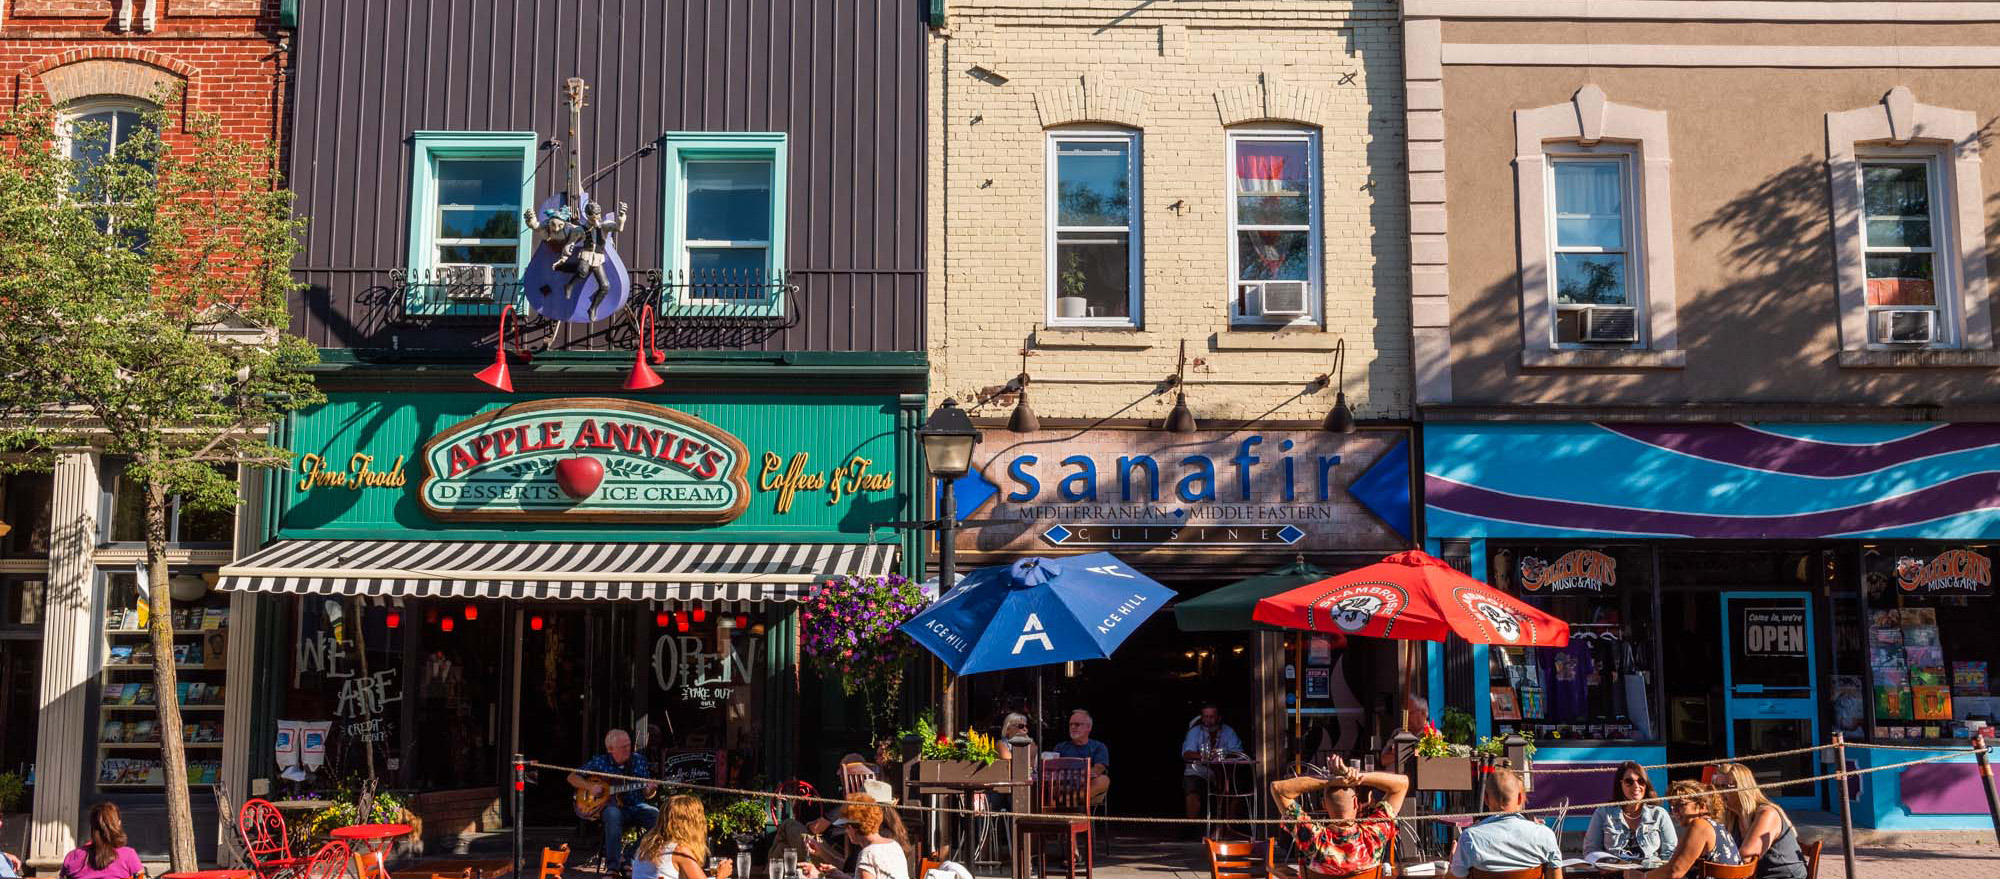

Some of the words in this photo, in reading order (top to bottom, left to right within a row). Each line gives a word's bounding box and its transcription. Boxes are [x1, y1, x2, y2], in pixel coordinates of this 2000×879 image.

[450, 420, 566, 478] APPLE
[572, 418, 724, 480] ANNIE'S
[300, 452, 345, 491] Fine
[349, 452, 407, 490] Foods
[760, 451, 825, 515] Coffees
[829, 467, 847, 505] &
[847, 456, 895, 493] Teas
[1007, 435, 1341, 503] sanafir
[439, 485, 560, 500] DESSERTS
[600, 486, 638, 501] ICE
[643, 486, 724, 501] CREAM
[1019, 506, 1168, 520] MEDITERRANEAN
[1189, 506, 1255, 520] MIDDLE
[1259, 506, 1331, 520] EASTERN
[1097, 614, 1122, 635] ACE
[1118, 594, 1148, 615] HILL
[1319, 587, 1399, 616] ST-AMBROISE
[1748, 612, 1769, 622] Come
[296, 631, 354, 678] WE
[925, 619, 949, 638] ACE
[946, 634, 968, 653] HILL
[1748, 625, 1804, 652] OPEN
[651, 635, 759, 691] OPEN
[333, 668, 403, 718] ARE
[688, 687, 710, 700] TAKE
[714, 687, 734, 699] OUT
